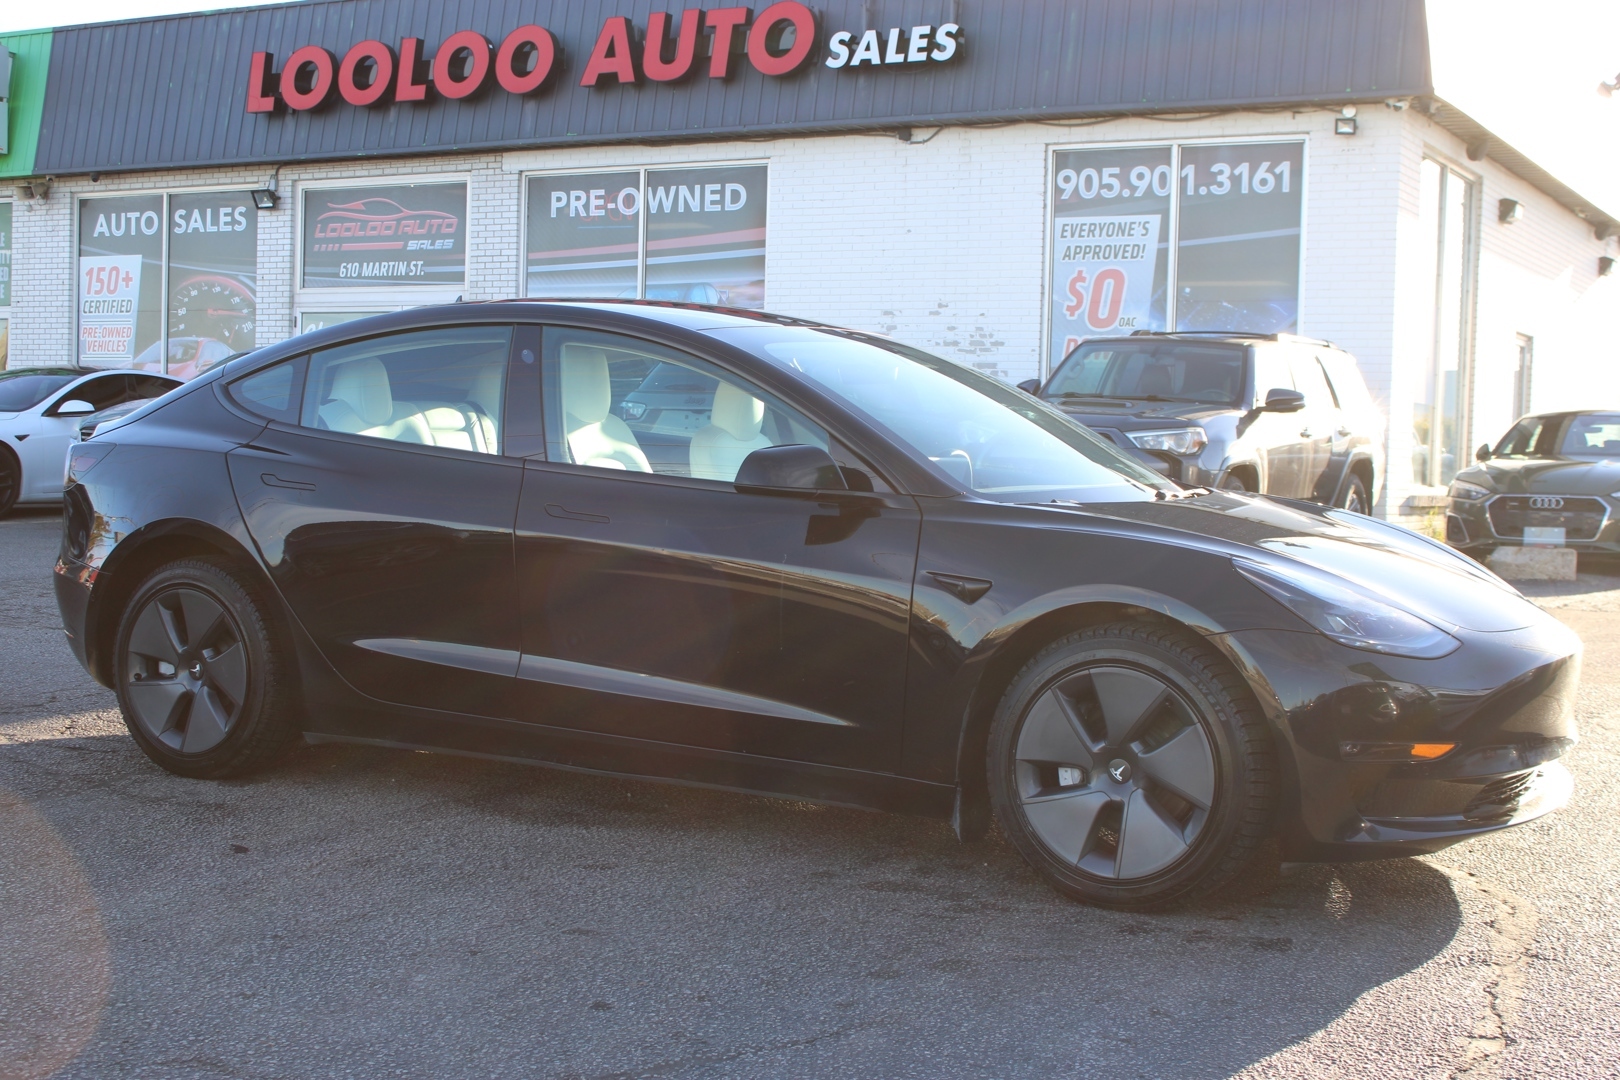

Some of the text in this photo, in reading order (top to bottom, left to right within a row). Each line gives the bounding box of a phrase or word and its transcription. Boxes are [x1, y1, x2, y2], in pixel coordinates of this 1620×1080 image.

[246, 1, 960, 113] LOOLOO AUTO SALES
[1056, 161, 1291, 200] 905.901.3161
[550, 183, 747, 218] PRE-OWNED
[93, 206, 247, 237] AUTO SALES
[314, 218, 458, 238] LOOLOO AUTO
[1060, 221, 1150, 239] EVERYONE'S
[406, 239, 454, 250] SALES
[1062, 243, 1146, 261] APPROVED!
[339, 261, 425, 278] 610 MARTIN ST.
[85, 266, 134, 296] 150+
[83, 299, 133, 315] CERTIFIED
[1065, 268, 1126, 329] $0
[178, 307, 187, 316] 50
[242, 321, 253, 333] 210
[1118, 316, 1137, 328] OAC
[81, 326, 132, 340] PRE-OWNED
[87, 339, 127, 353] VEHICLES
